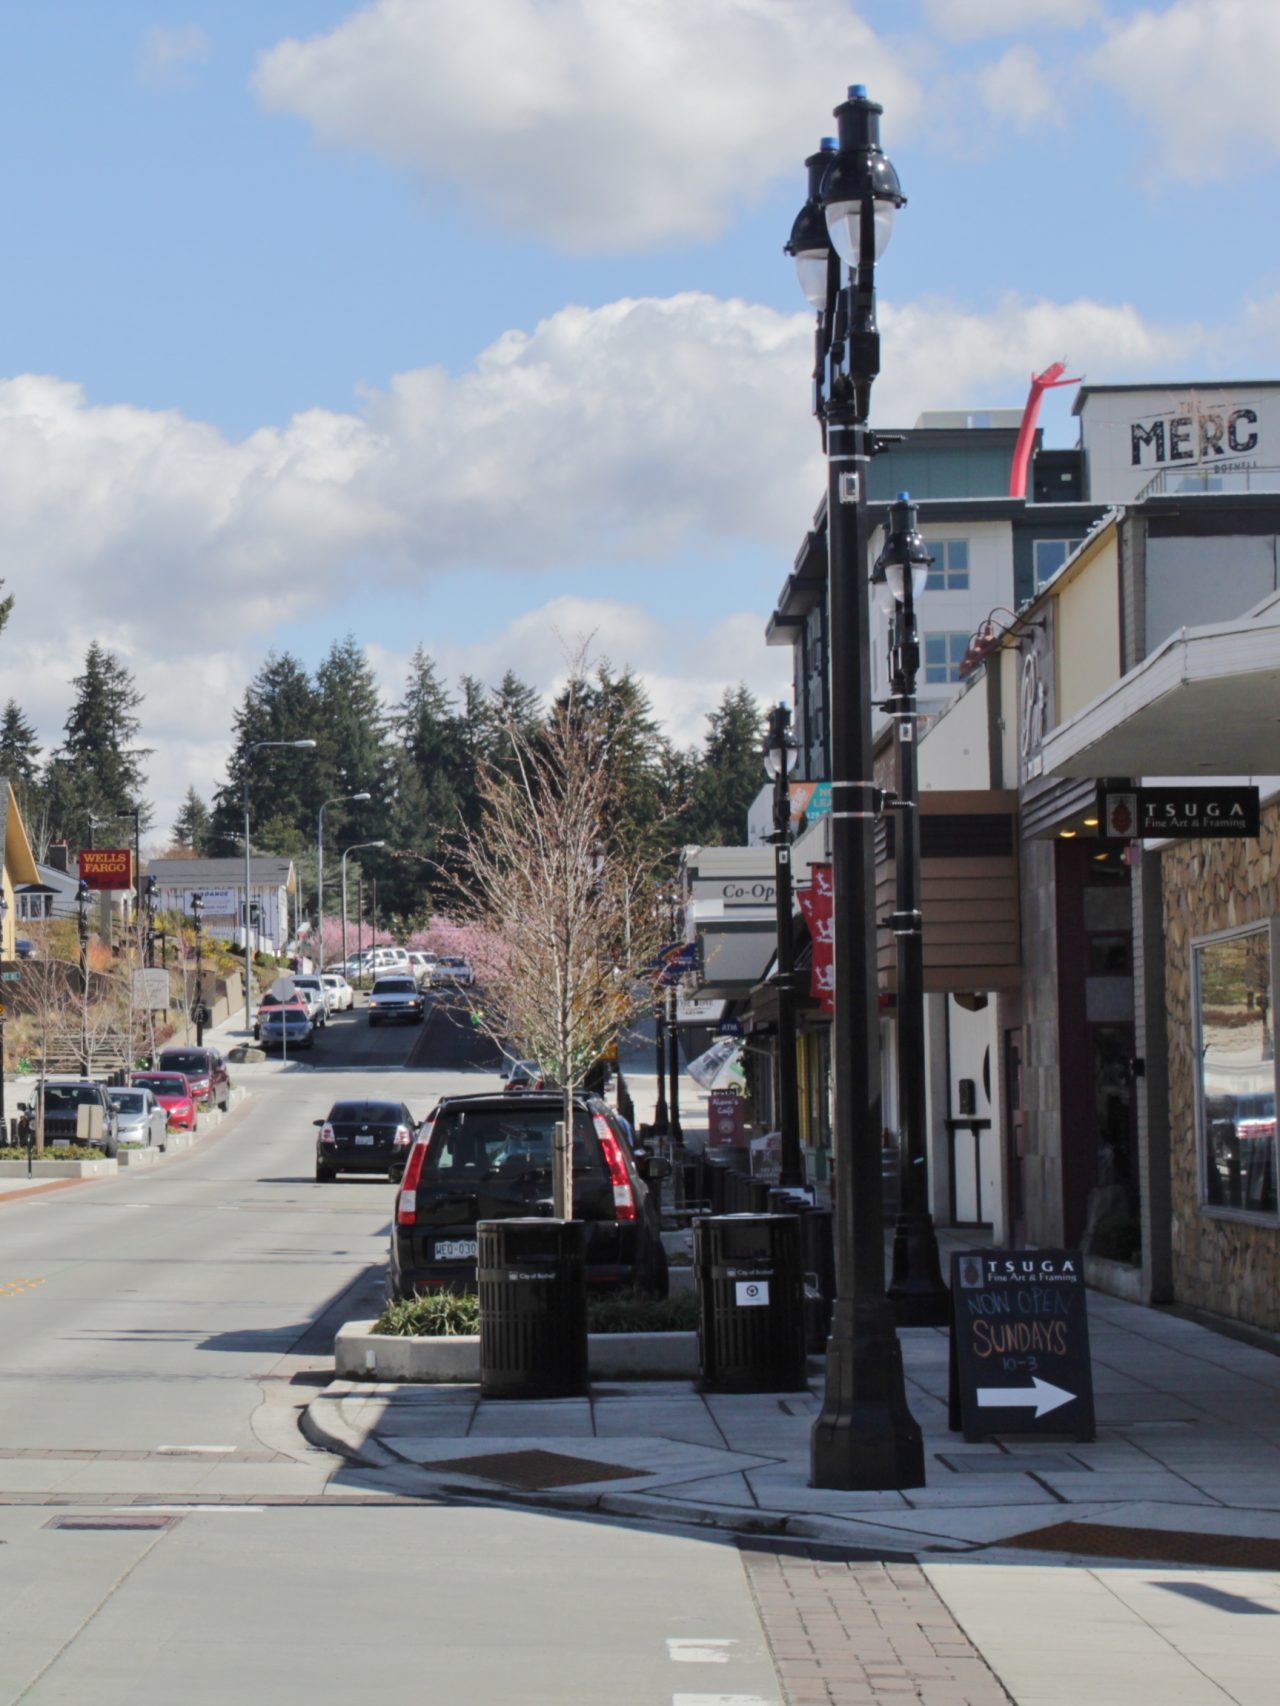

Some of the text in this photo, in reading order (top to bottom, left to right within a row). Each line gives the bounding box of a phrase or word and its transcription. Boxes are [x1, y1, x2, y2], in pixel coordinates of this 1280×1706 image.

[1131, 408, 1259, 466] MERC
[1145, 803, 1245, 817] TSUGA
[1145, 817, 1168, 828] Fine
[1170, 817, 1189, 828] Art
[1203, 817, 1247, 829] Framing
[83, 853, 126, 863] WELLS
[84, 863, 126, 873] FARGO
[721, 1023, 738, 1032] ATM
[988, 1260, 1075, 1273] TSUGA
[988, 1273, 1007, 1281] Fine
[1010, 1273, 1026, 1281] Art
[1039, 1273, 1078, 1283] Framing
[967, 1287, 1073, 1315] NOW OPEN
[972, 1319, 1068, 1358] SUNDAYS
